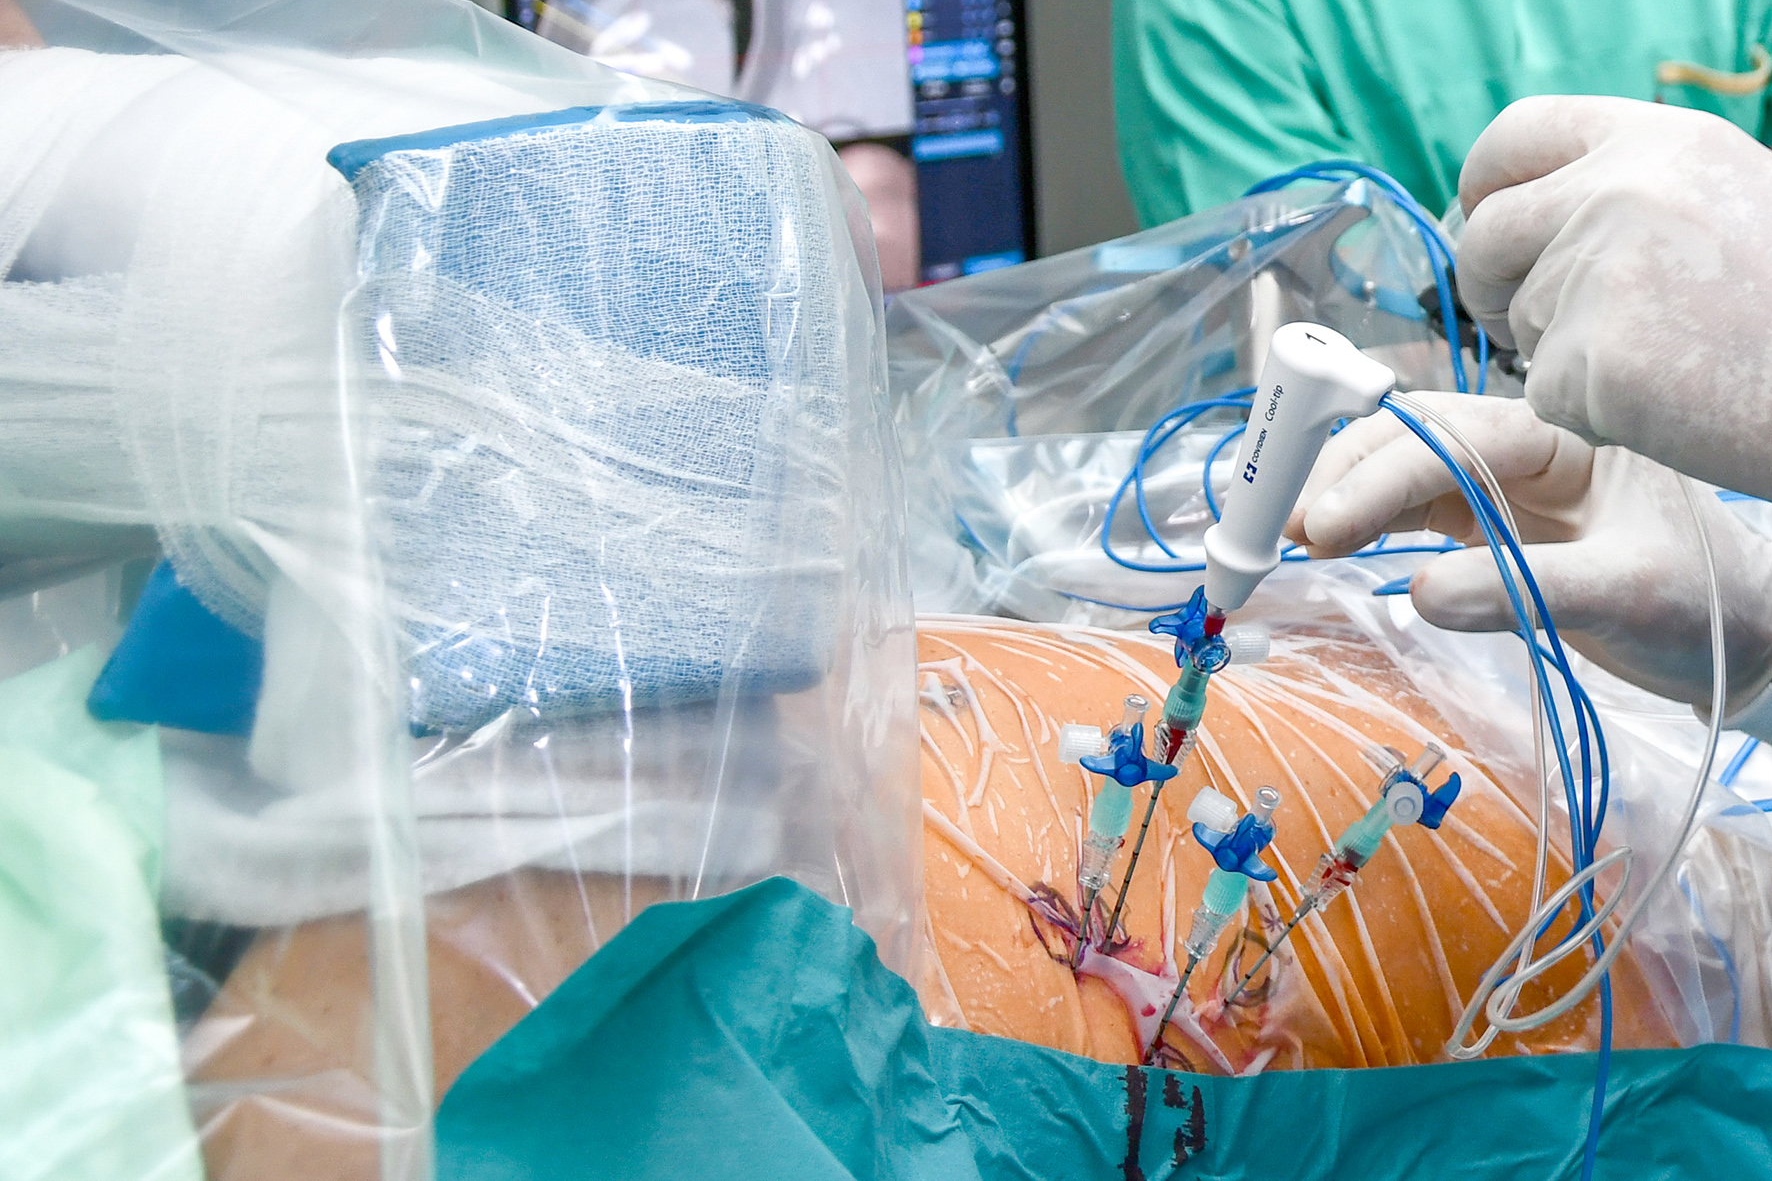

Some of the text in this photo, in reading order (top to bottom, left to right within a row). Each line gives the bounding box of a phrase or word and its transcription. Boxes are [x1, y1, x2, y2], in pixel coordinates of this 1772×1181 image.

[1305, 332, 1327, 345] 1
[1251, 384, 1284, 463] COVIDIEN Cool-tip
